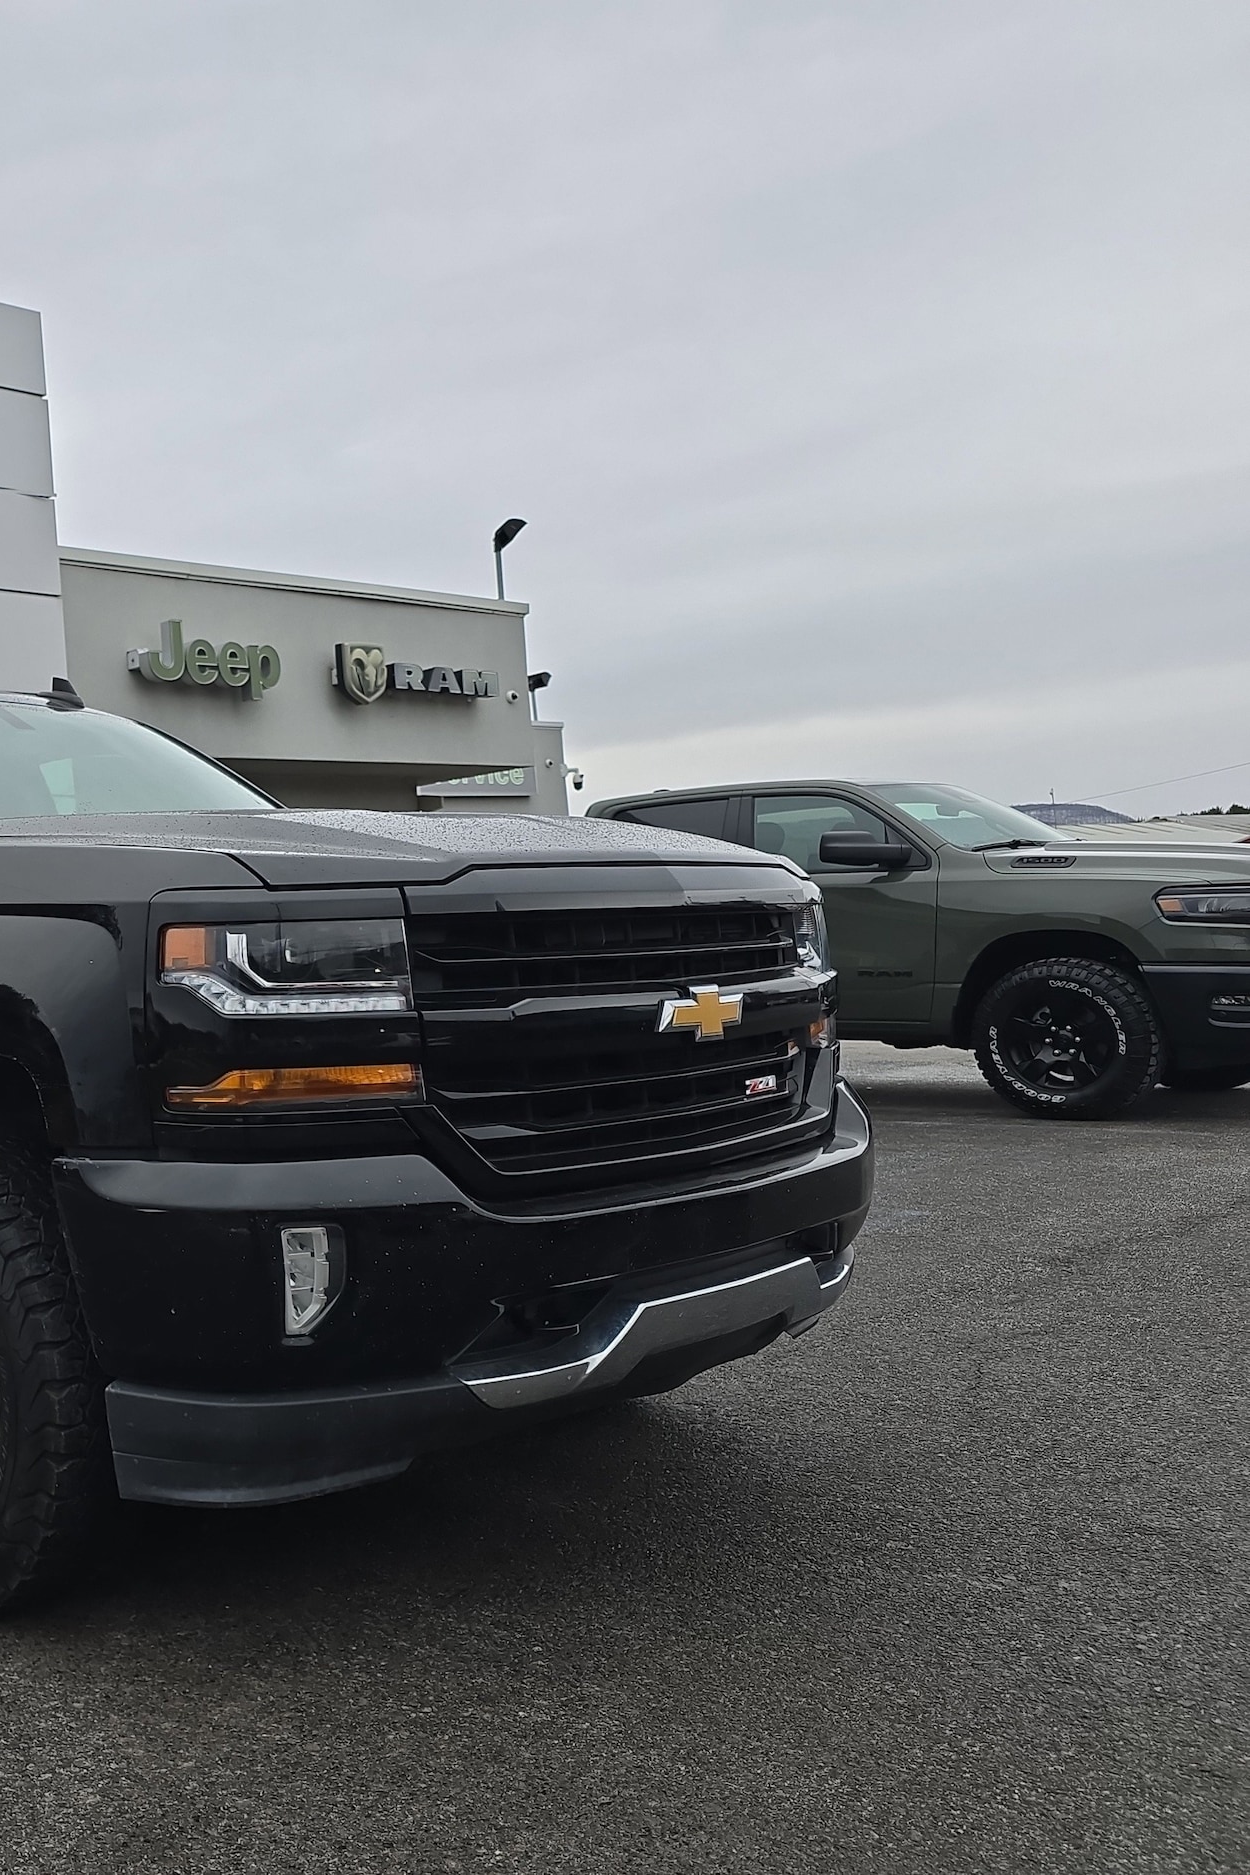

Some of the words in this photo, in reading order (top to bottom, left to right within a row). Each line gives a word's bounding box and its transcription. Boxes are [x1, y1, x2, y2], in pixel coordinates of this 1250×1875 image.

[140, 620, 281, 700] Jeep
[390, 662, 499, 698] RAM
[1049, 979, 1127, 1055] WRANGLER
[745, 1075, 777, 1095] Z71
[989, 1026, 1066, 1103] GOODYEAR
